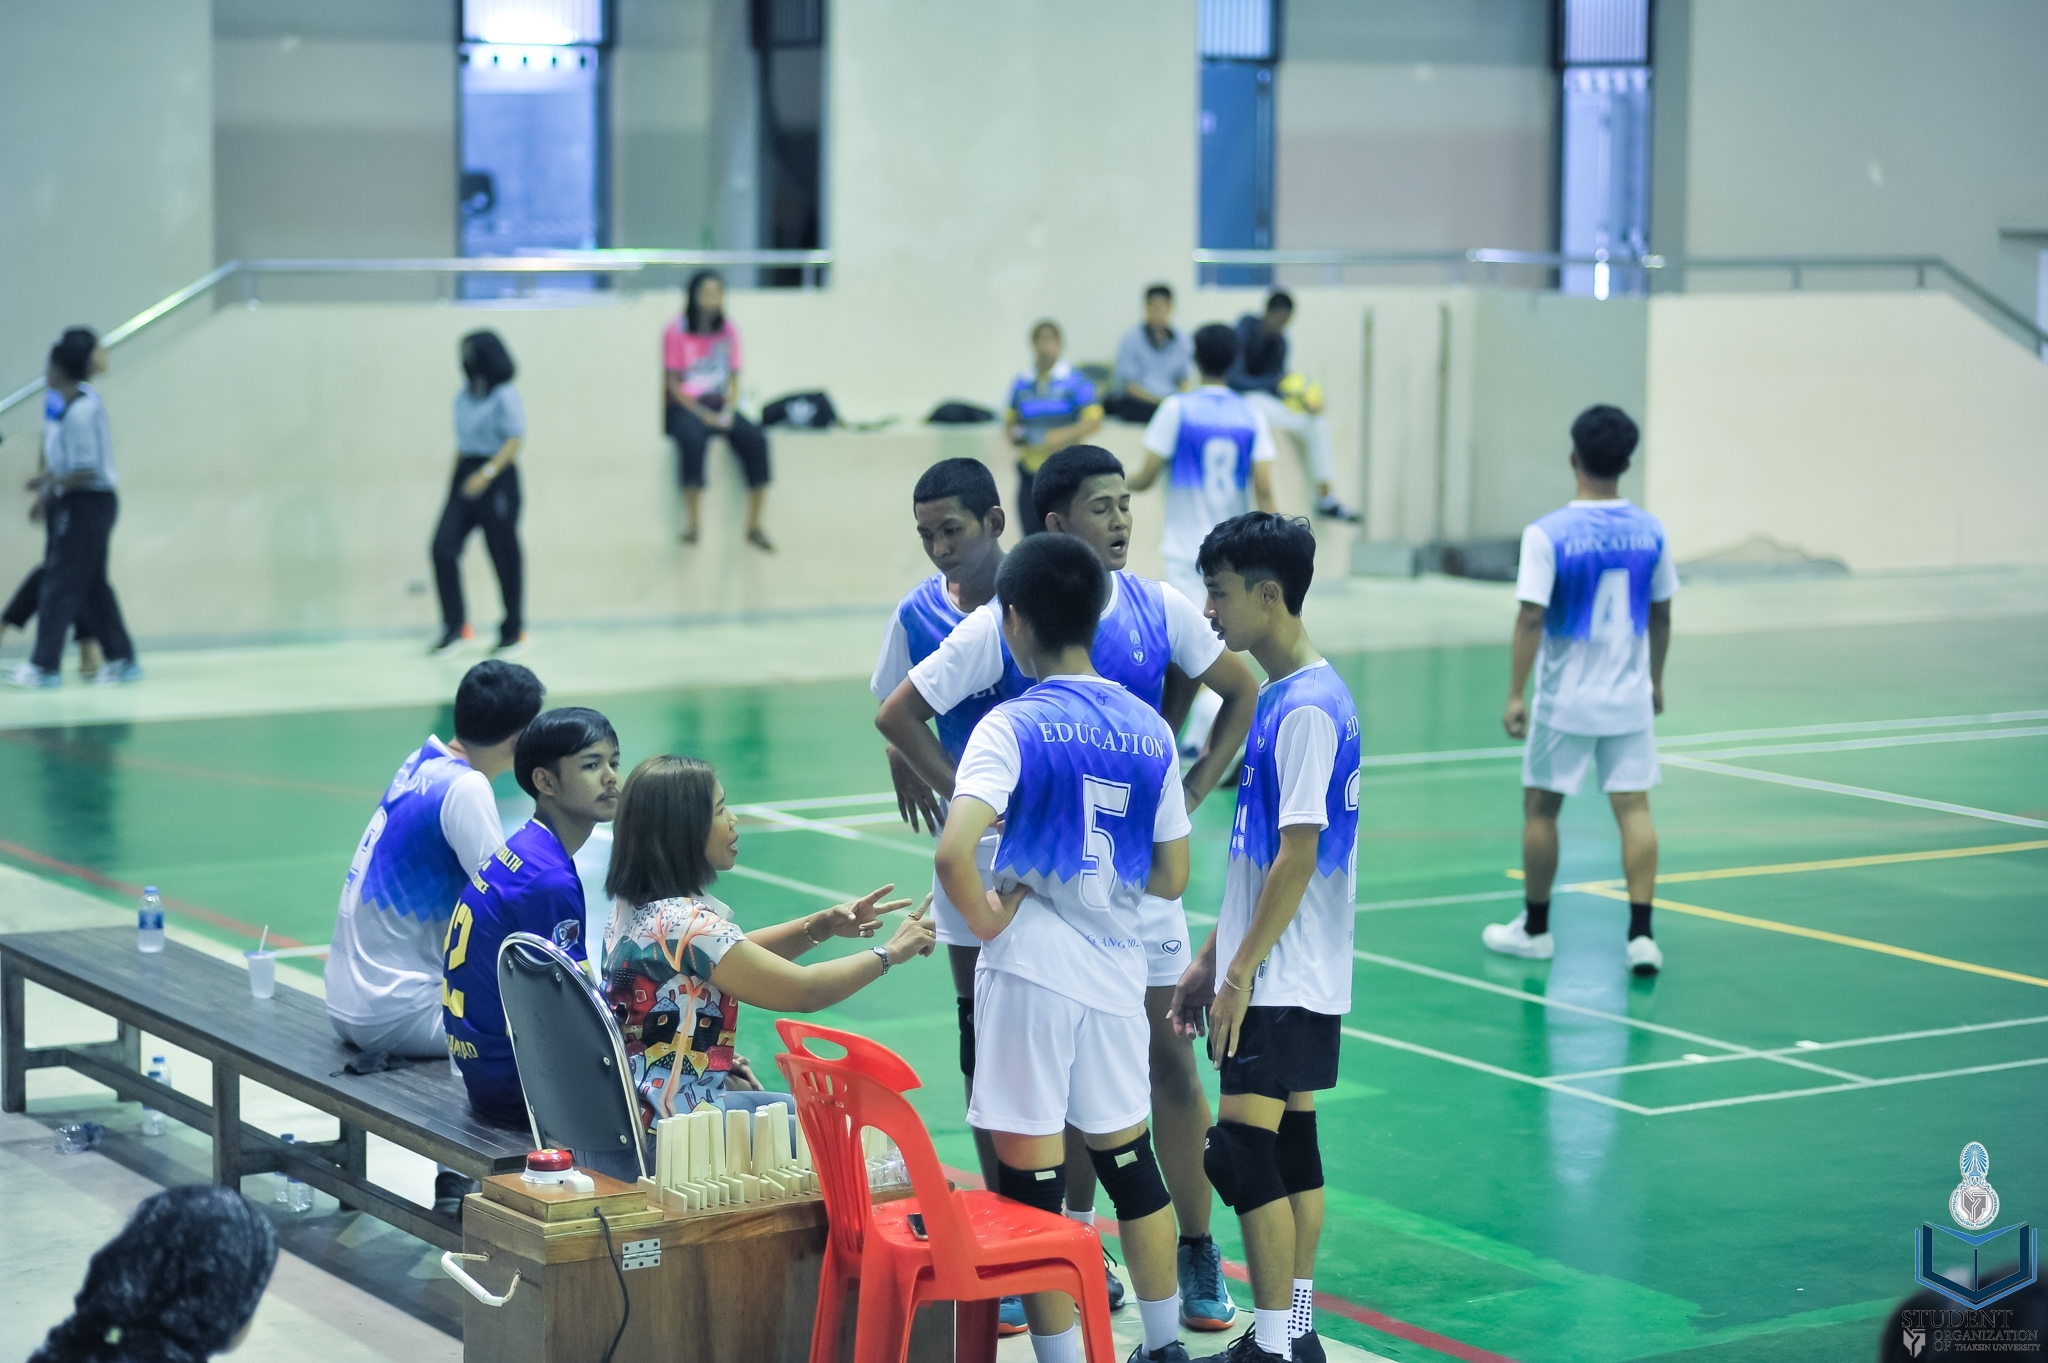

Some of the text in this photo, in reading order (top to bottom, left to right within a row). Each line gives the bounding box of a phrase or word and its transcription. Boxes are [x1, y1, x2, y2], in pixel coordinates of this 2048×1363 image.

[1203, 437, 1239, 506] 8
[1590, 567, 1634, 657] 4
[1038, 721, 1164, 760] EDUCATION
[1078, 773, 1131, 912] 5
